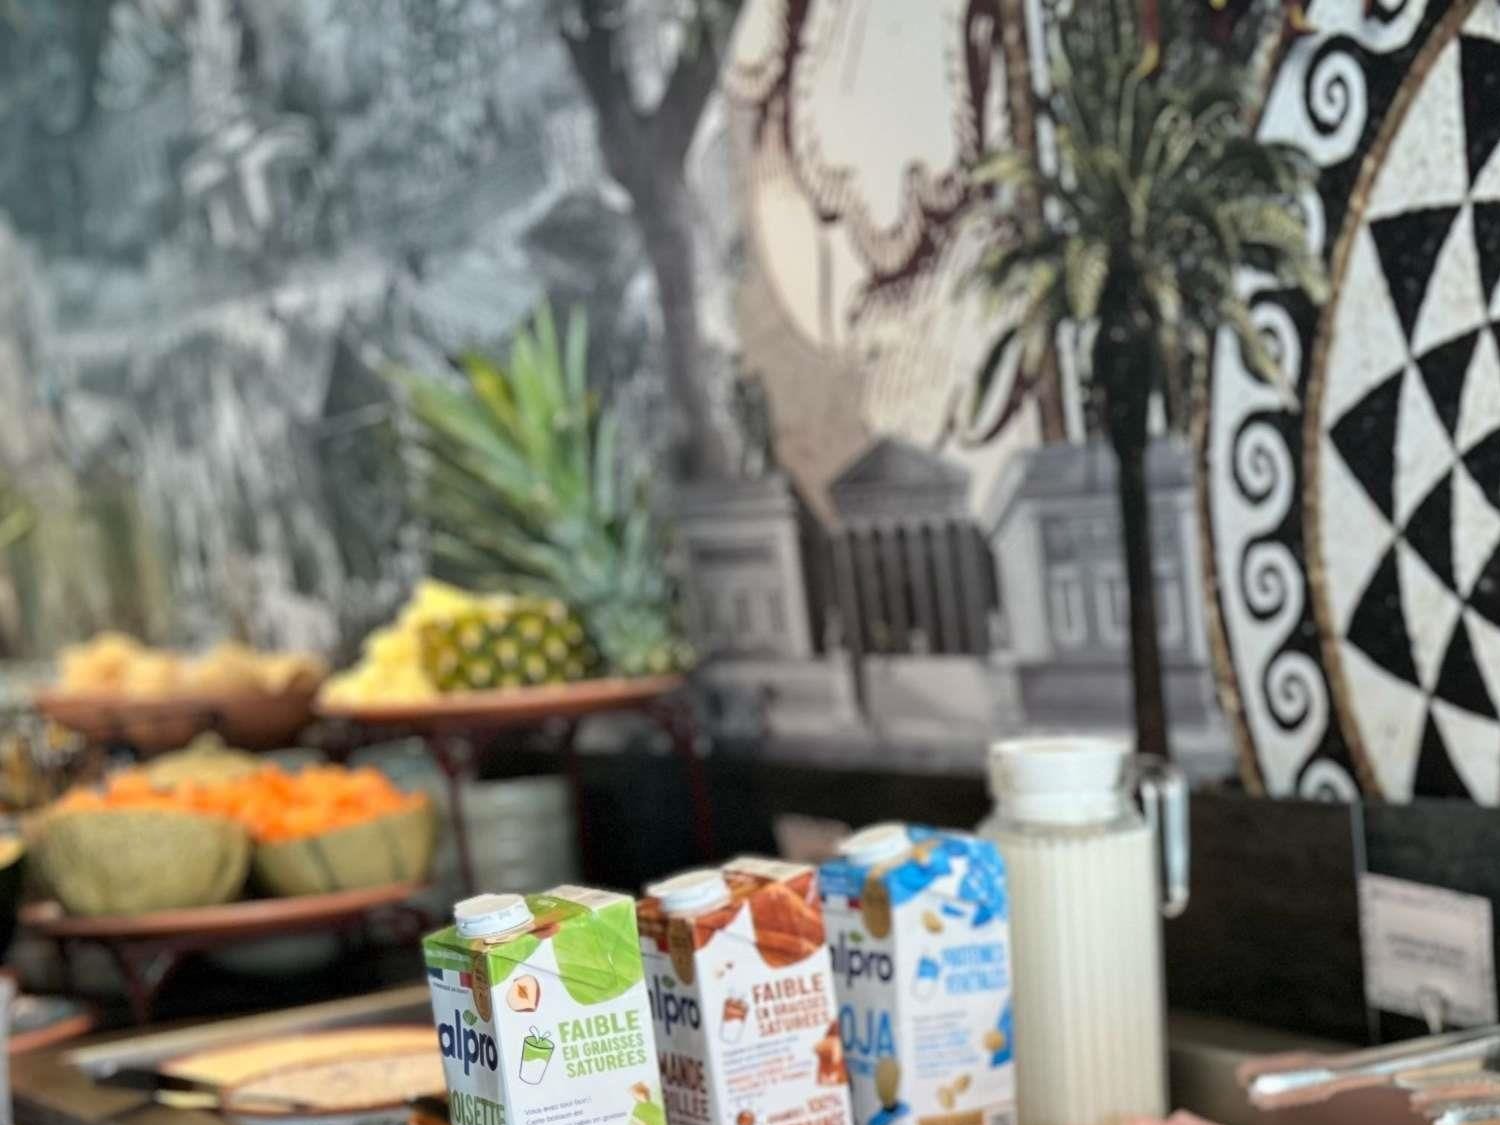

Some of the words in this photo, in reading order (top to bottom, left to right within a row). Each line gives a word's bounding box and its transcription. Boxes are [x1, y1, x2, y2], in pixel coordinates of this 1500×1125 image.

[752, 974, 823, 1002] FAIBLE
[438, 1009, 498, 1076] alpro
[558, 1010, 640, 1044] FAIBLE
[839, 1004, 896, 1056] OJA
[562, 1046, 581, 1062] EN
[584, 1033, 645, 1057] GRAISSES
[566, 1050, 648, 1079] SATURÉES
[658, 1053, 707, 1094] MANDE
